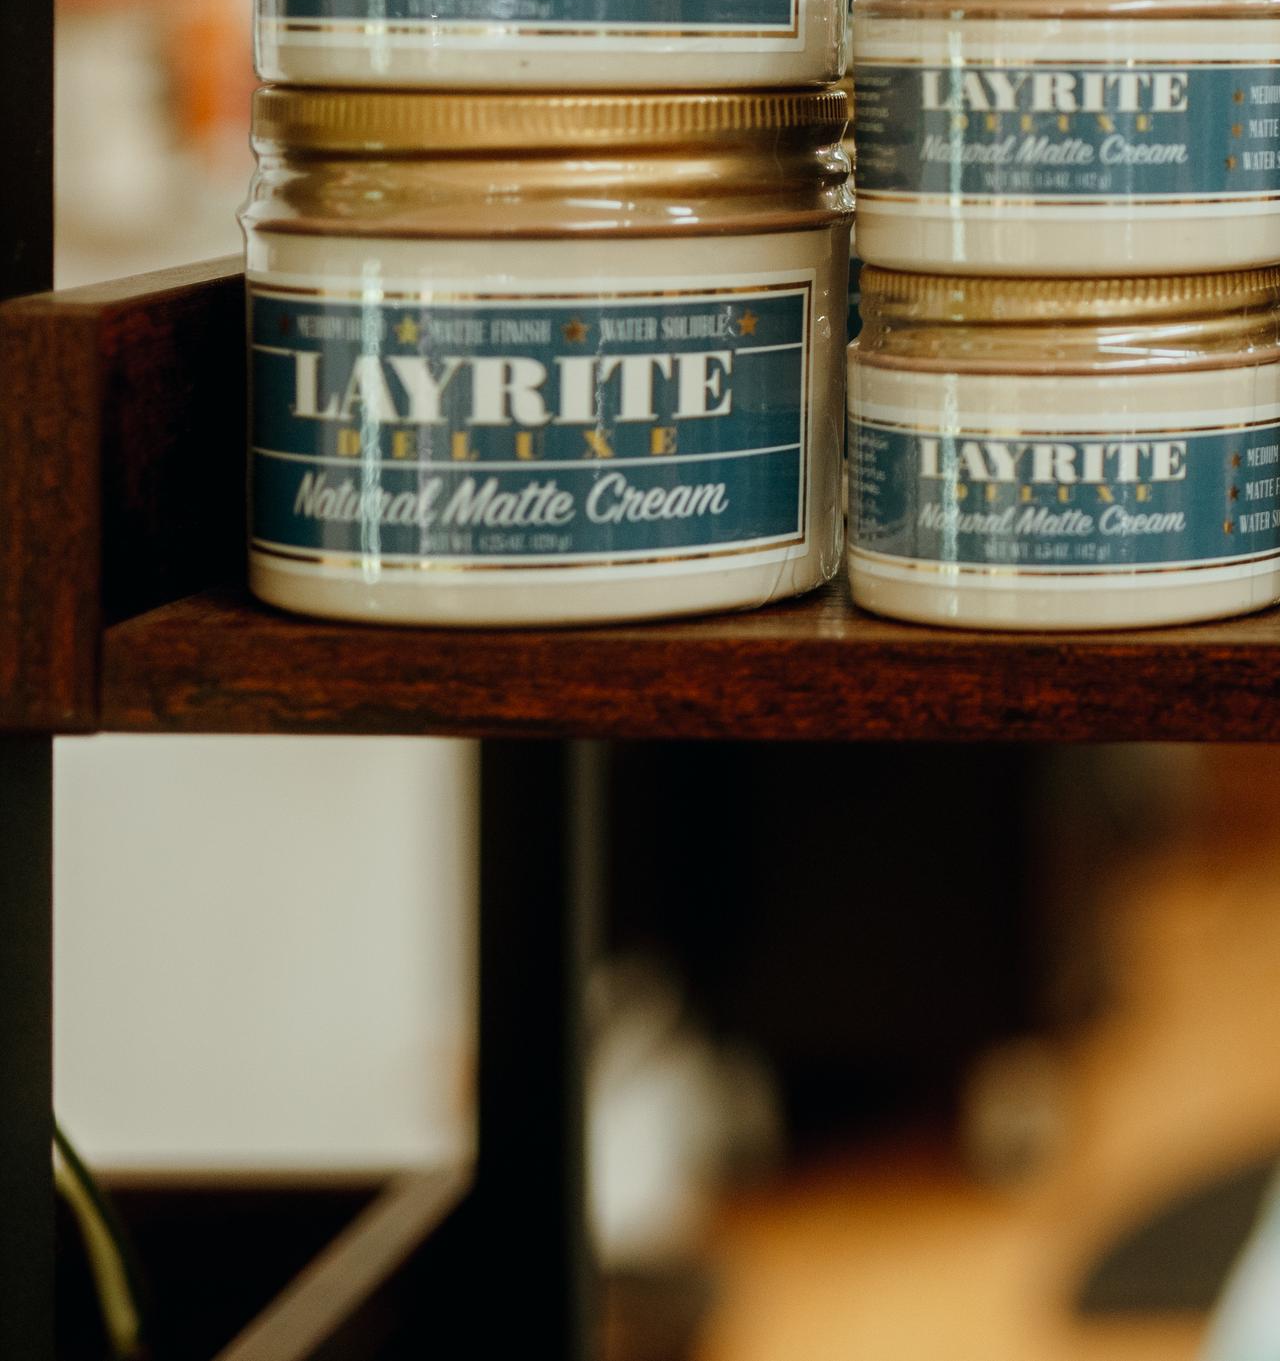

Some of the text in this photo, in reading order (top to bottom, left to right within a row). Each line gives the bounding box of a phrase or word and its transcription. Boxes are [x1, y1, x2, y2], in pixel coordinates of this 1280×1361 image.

[919, 70, 1189, 113] LAYRITE
[919, 133, 1189, 166] Natural Matte Cream
[1242, 150, 1276, 170] WATER
[292, 350, 734, 427] LAYRITE
[918, 439, 1188, 483] LAYRITE
[1247, 444, 1279, 467] MEDIUM
[294, 472, 730, 527] Natural Matte Cream
[1245, 477, 1275, 501] MATTE
[917, 502, 1187, 537] Natural Matte Cream
[1239, 510, 1271, 533] WATER
